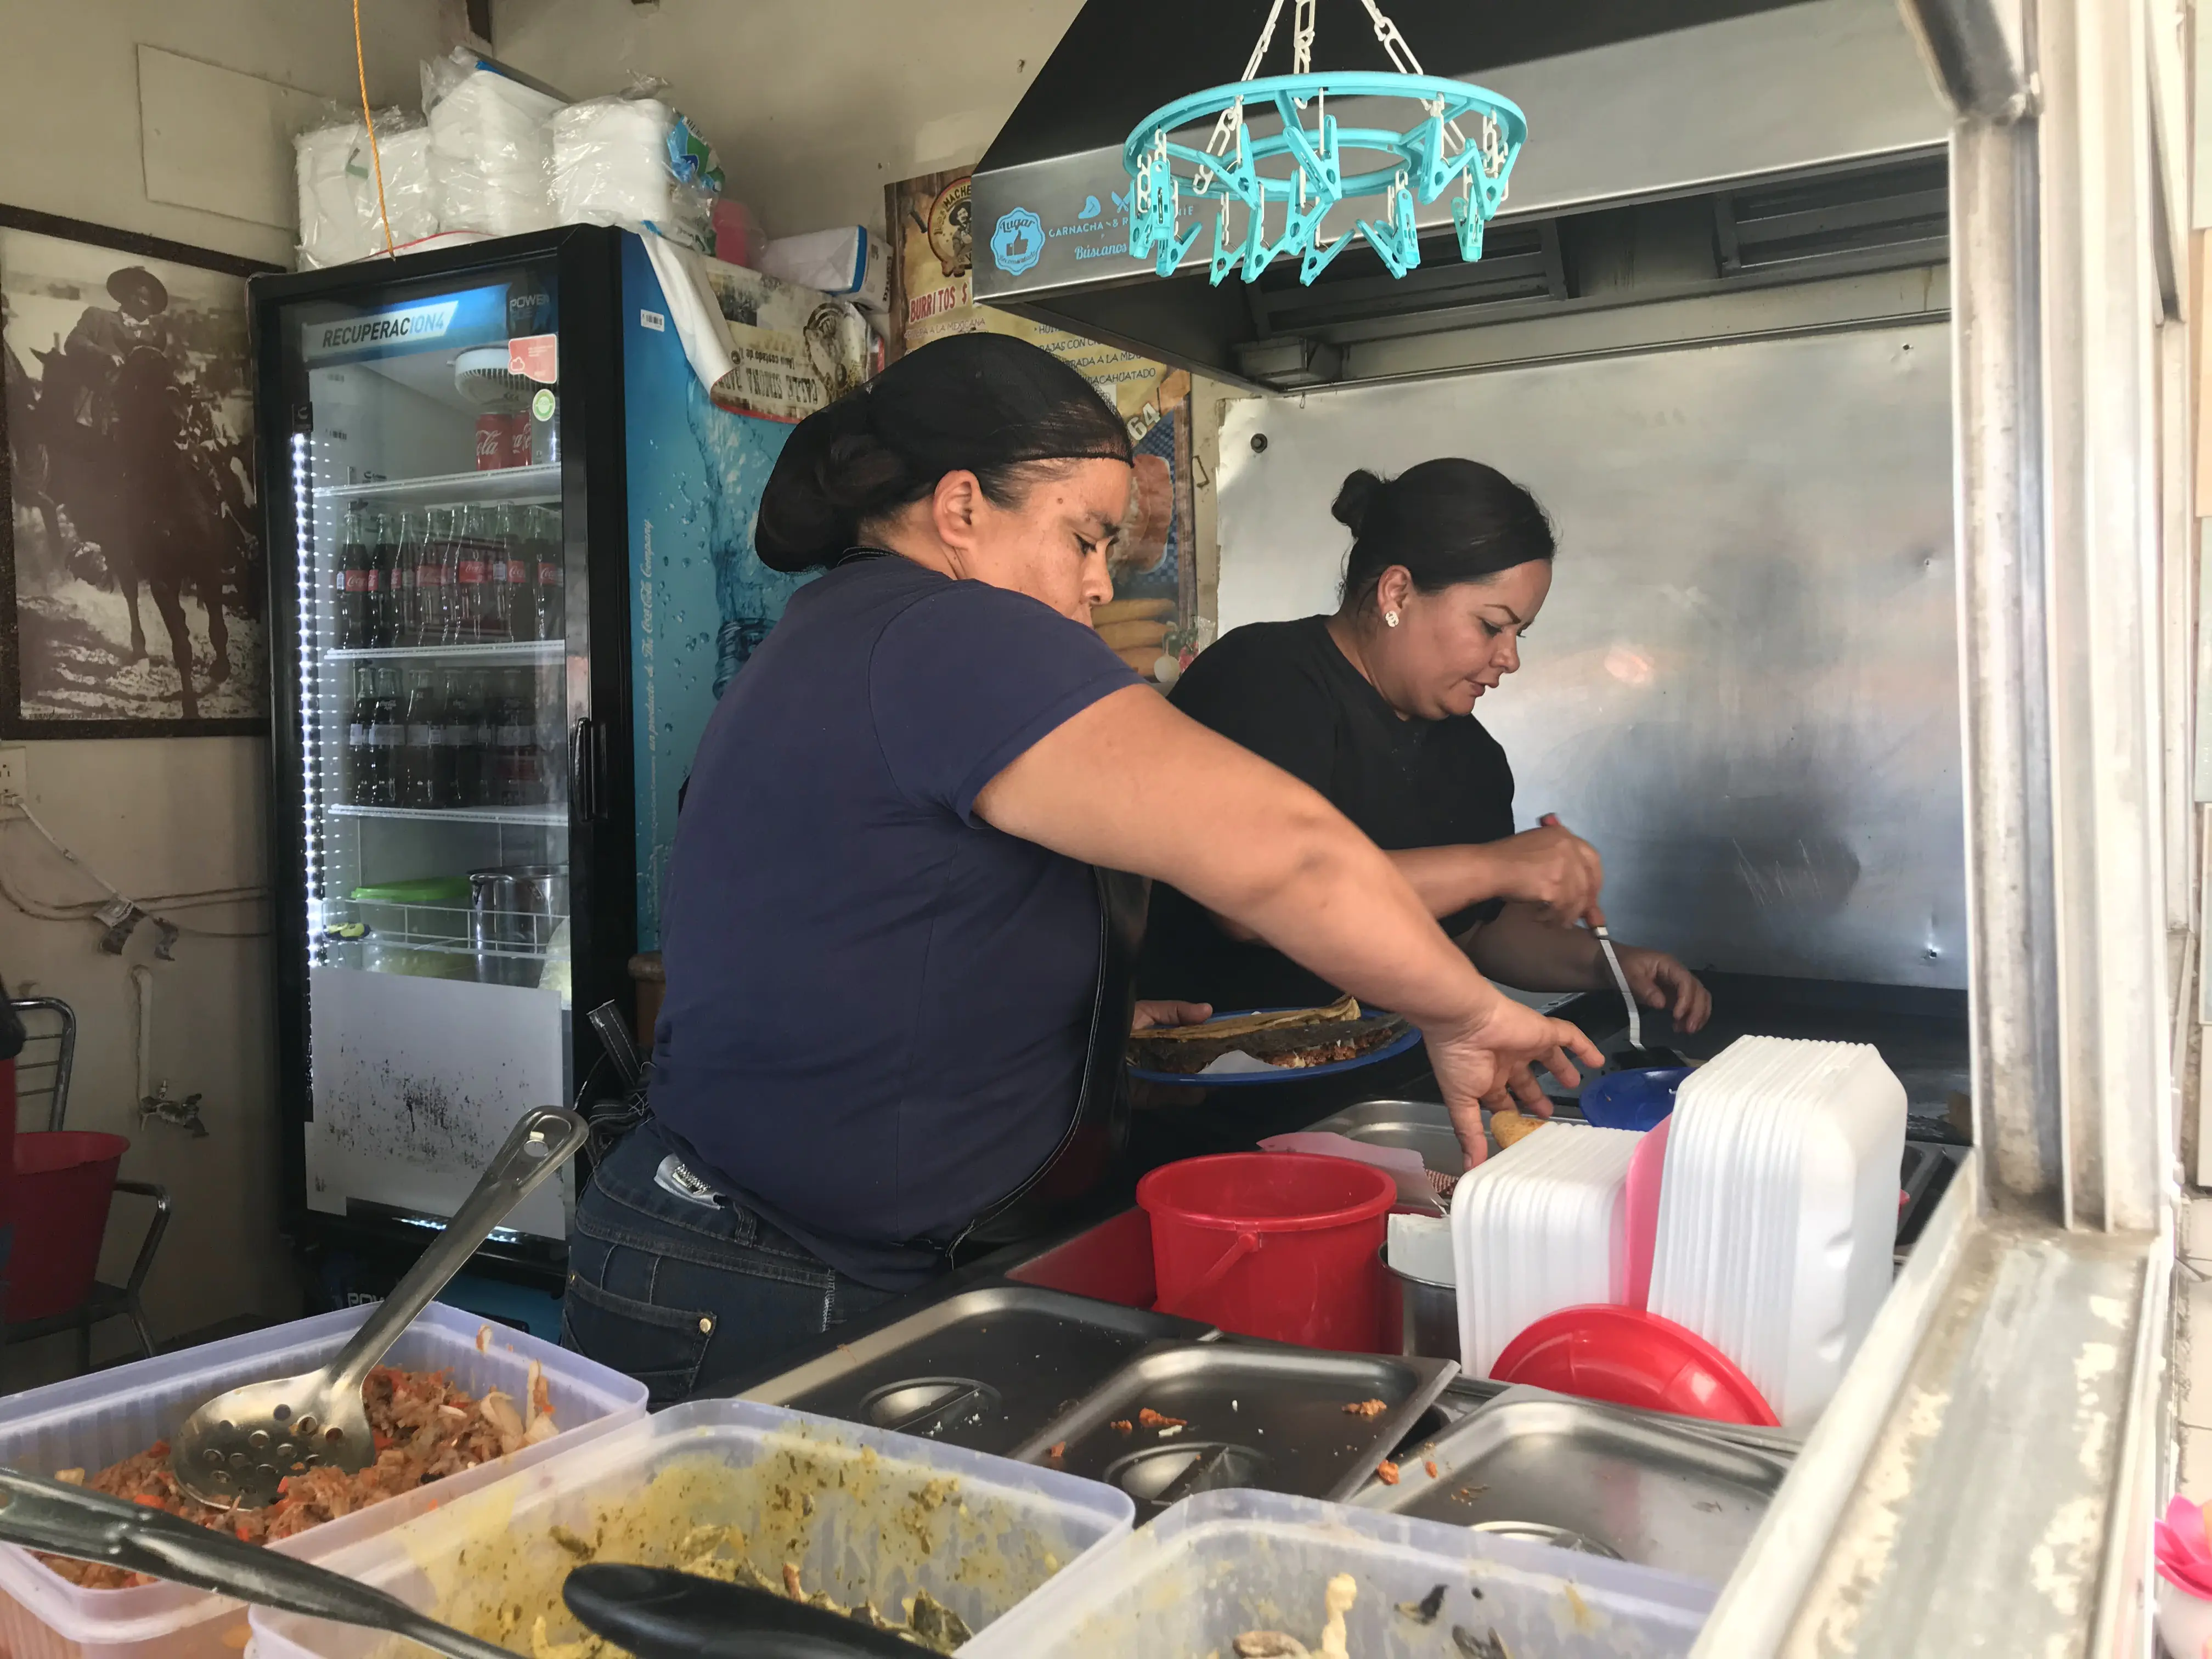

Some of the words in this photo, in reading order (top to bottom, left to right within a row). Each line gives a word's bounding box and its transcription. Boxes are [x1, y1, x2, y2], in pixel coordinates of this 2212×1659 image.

[1000, 219, 1035, 233] Lugar
[910, 286, 956, 323] BURRITOS
[961, 282, 968, 305] $
[947, 317, 986, 331] MEXICANA
[1066, 338, 1086, 349] CON
[1097, 356, 1104, 364] A
[1106, 354, 1118, 363] LA
[1126, 402, 1161, 441] 64
[645, 680, 658, 736] producto
